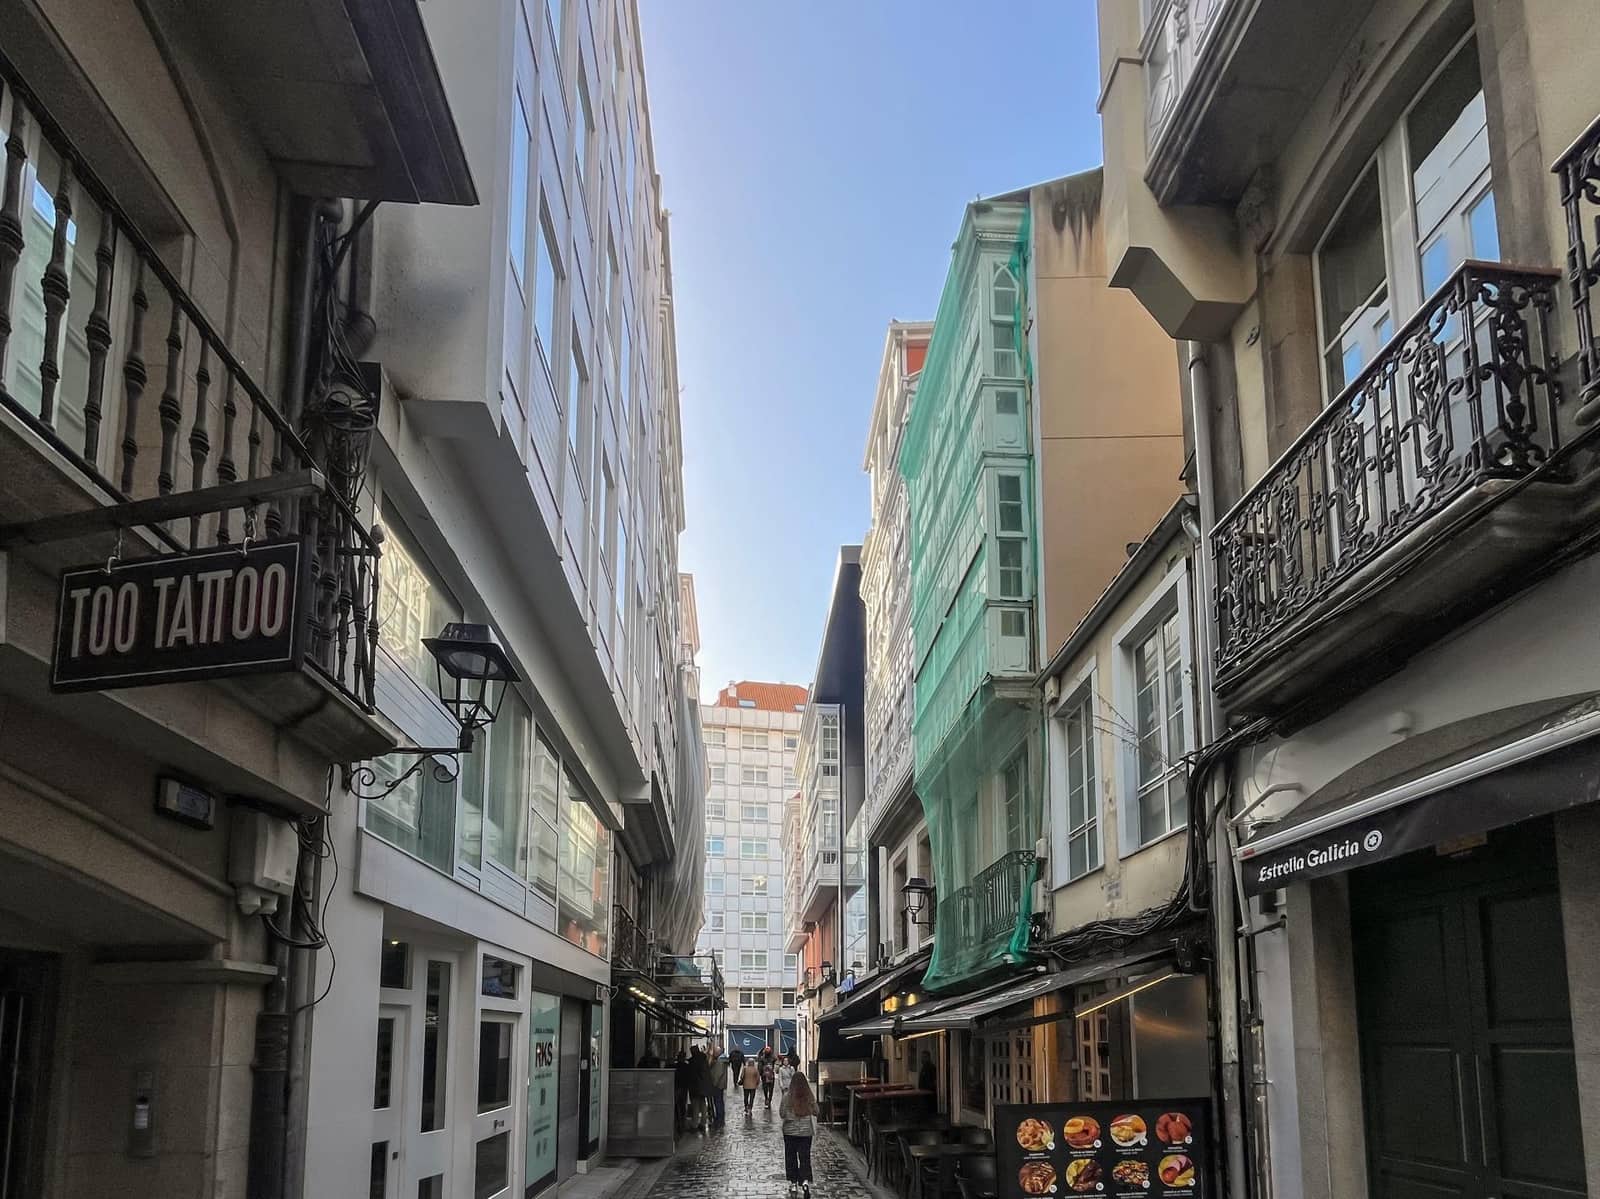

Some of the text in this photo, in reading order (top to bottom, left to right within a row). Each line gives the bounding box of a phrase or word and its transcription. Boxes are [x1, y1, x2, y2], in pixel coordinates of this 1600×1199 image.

[70, 562, 287, 658] TOO TATTOO
[1258, 839, 1359, 882] Estrella Galicia
